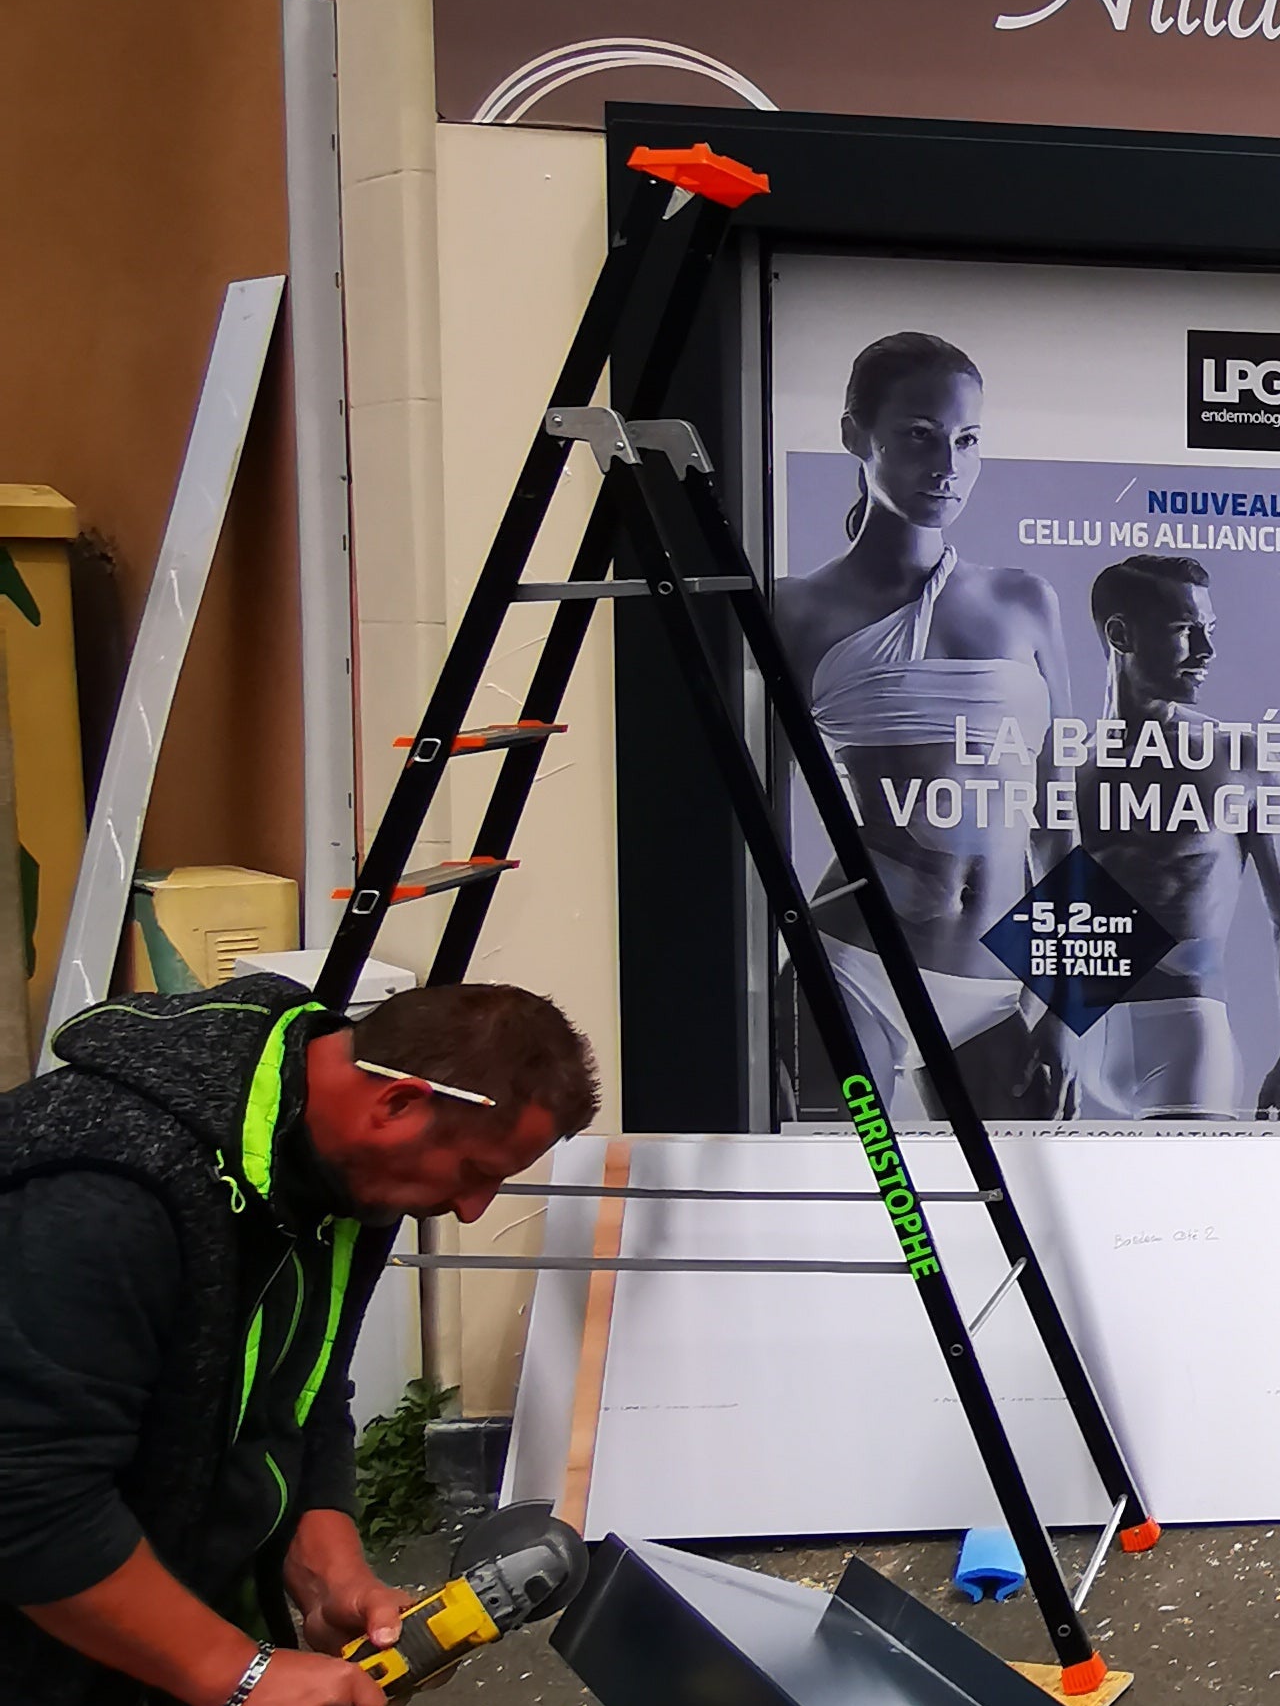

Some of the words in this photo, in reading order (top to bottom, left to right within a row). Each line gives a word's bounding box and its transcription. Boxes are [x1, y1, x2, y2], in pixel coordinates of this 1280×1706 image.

[1018, 518, 1101, 546] CELLU
[1110, 521, 1149, 548] M6
[955, 715, 1031, 766] LA
[880, 777, 1077, 831] VOTRE
[1031, 939, 1058, 957] DE
[1062, 939, 1118, 958] TOUR
[1031, 958, 1058, 976] DE
[1062, 958, 1132, 977] TAILLE
[841, 1073, 941, 1281] CHRISTOPHE
